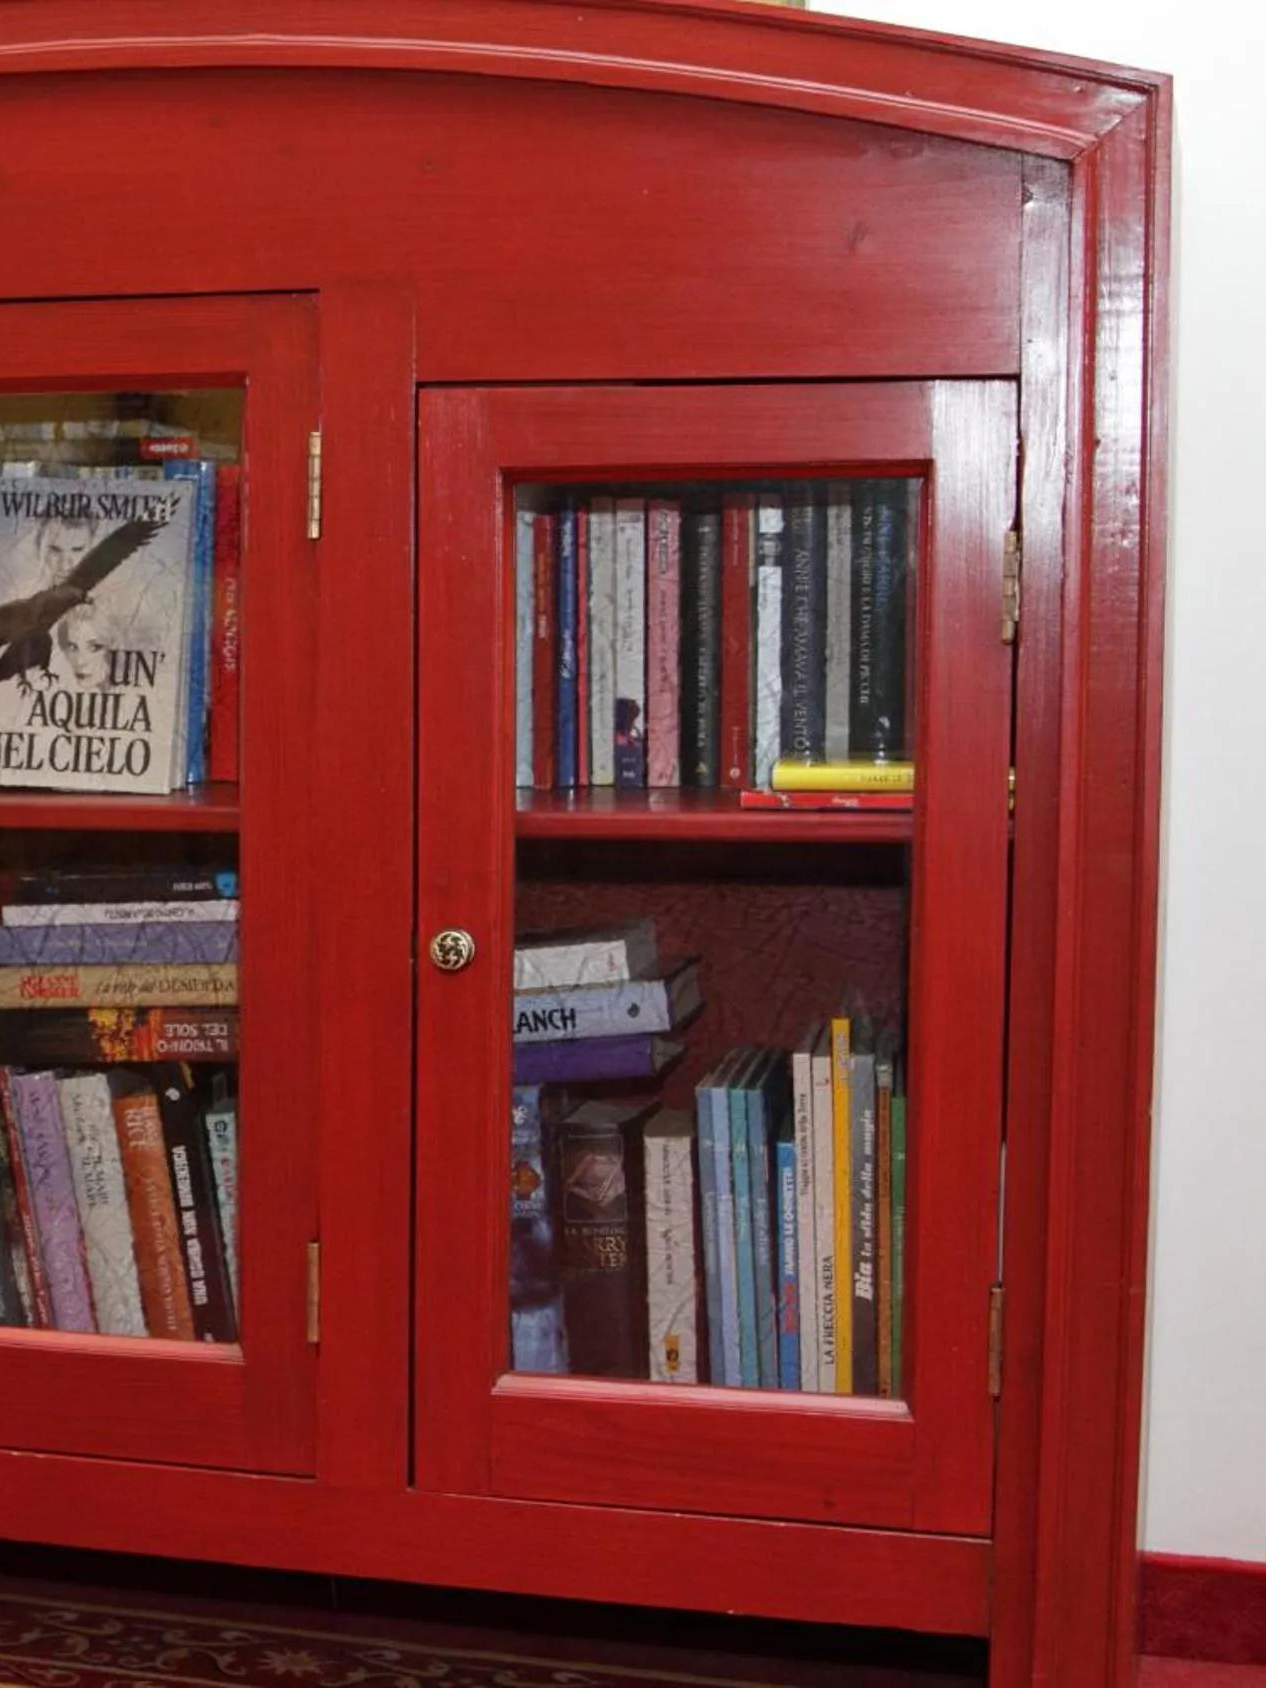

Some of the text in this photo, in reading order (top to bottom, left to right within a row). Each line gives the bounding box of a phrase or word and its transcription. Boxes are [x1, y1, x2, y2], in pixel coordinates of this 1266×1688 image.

[0, 491, 172, 523] WILBUR SMITH
[794, 549, 807, 591] ANNIE
[794, 596, 807, 624] CHE
[108, 649, 166, 688] UN'
[793, 628, 807, 680] AMAVA
[26, 690, 152, 734] AQUILA
[792, 702, 807, 749] VENTO
[48, 734, 151, 777] CIELO
[165, 1023, 227, 1037] DEL SOLE
[512, 1007, 577, 1034] ANCH
[156, 1039, 213, 1053] TRIONFO
[862, 1109, 875, 1154] magia
[859, 1162, 872, 1198] della
[860, 1242, 871, 1256] la
[821, 1255, 835, 1365] LA FRECCIA NERA
